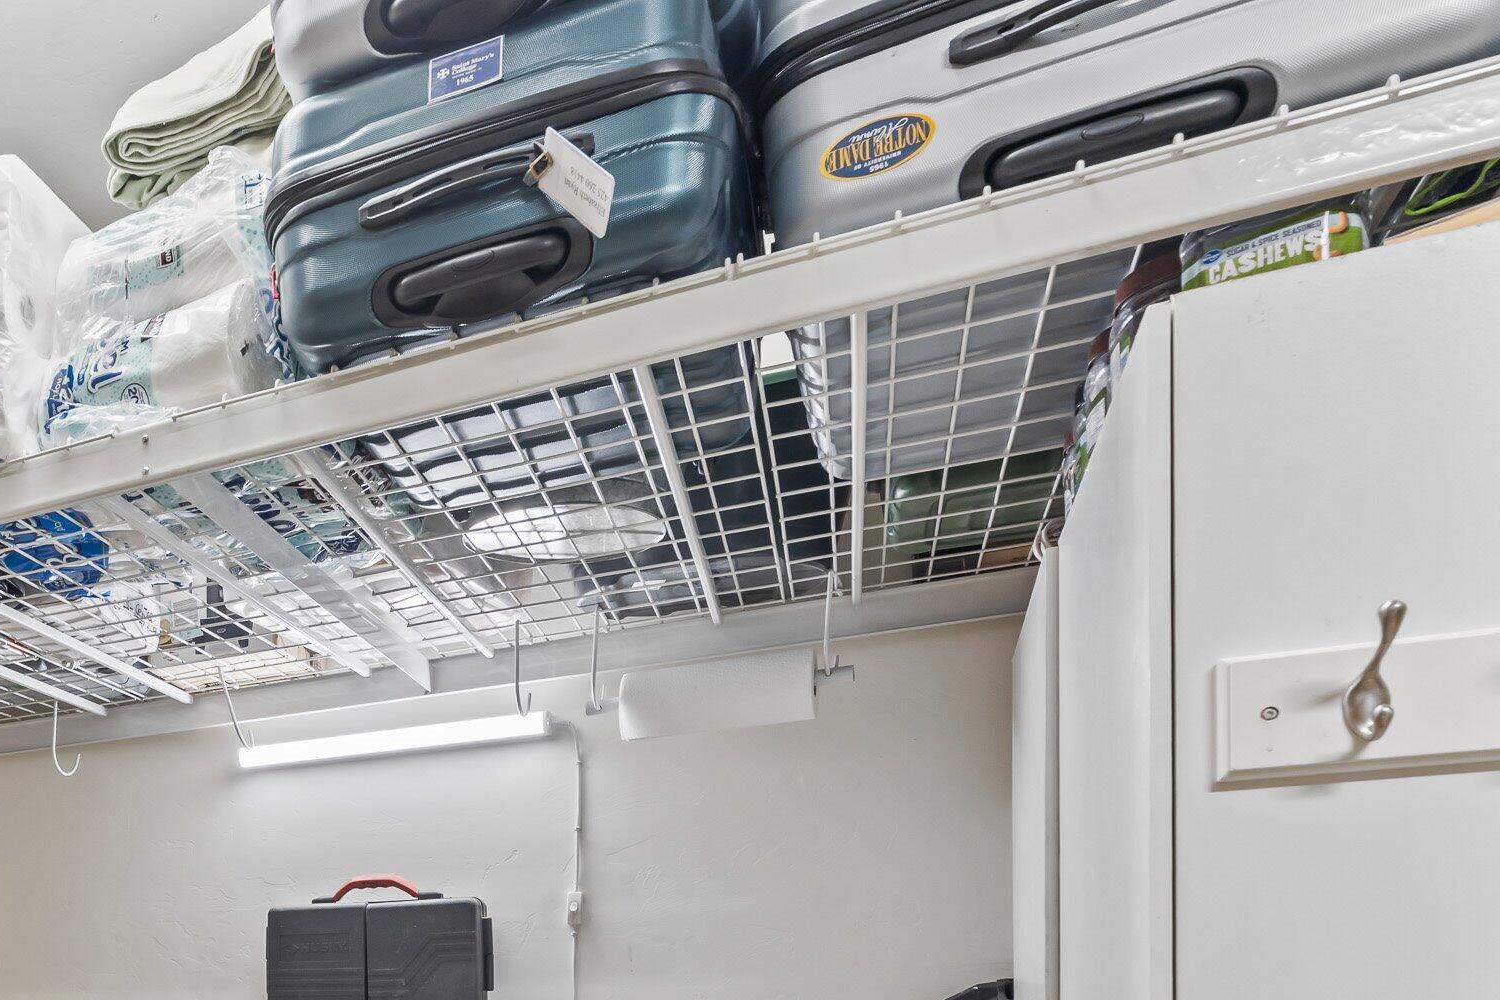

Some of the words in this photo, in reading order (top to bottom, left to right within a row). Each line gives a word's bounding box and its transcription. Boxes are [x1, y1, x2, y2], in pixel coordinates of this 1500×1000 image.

[451, 60, 470, 71] Saint
[471, 52, 495, 64] Mary's
[451, 63, 478, 75] College
[849, 117, 909, 143] Alumni
[873, 119, 928, 157] NOTRE
[828, 138, 870, 173] DAME
[853, 163, 862, 171] OF
[864, 151, 902, 168] UNIVERSITY
[1226, 243, 1250, 258] SUGAR
[1258, 233, 1279, 247] SPICE
[1282, 219, 1322, 239] SEASONED
[1208, 229, 1324, 285] CASHEWS
